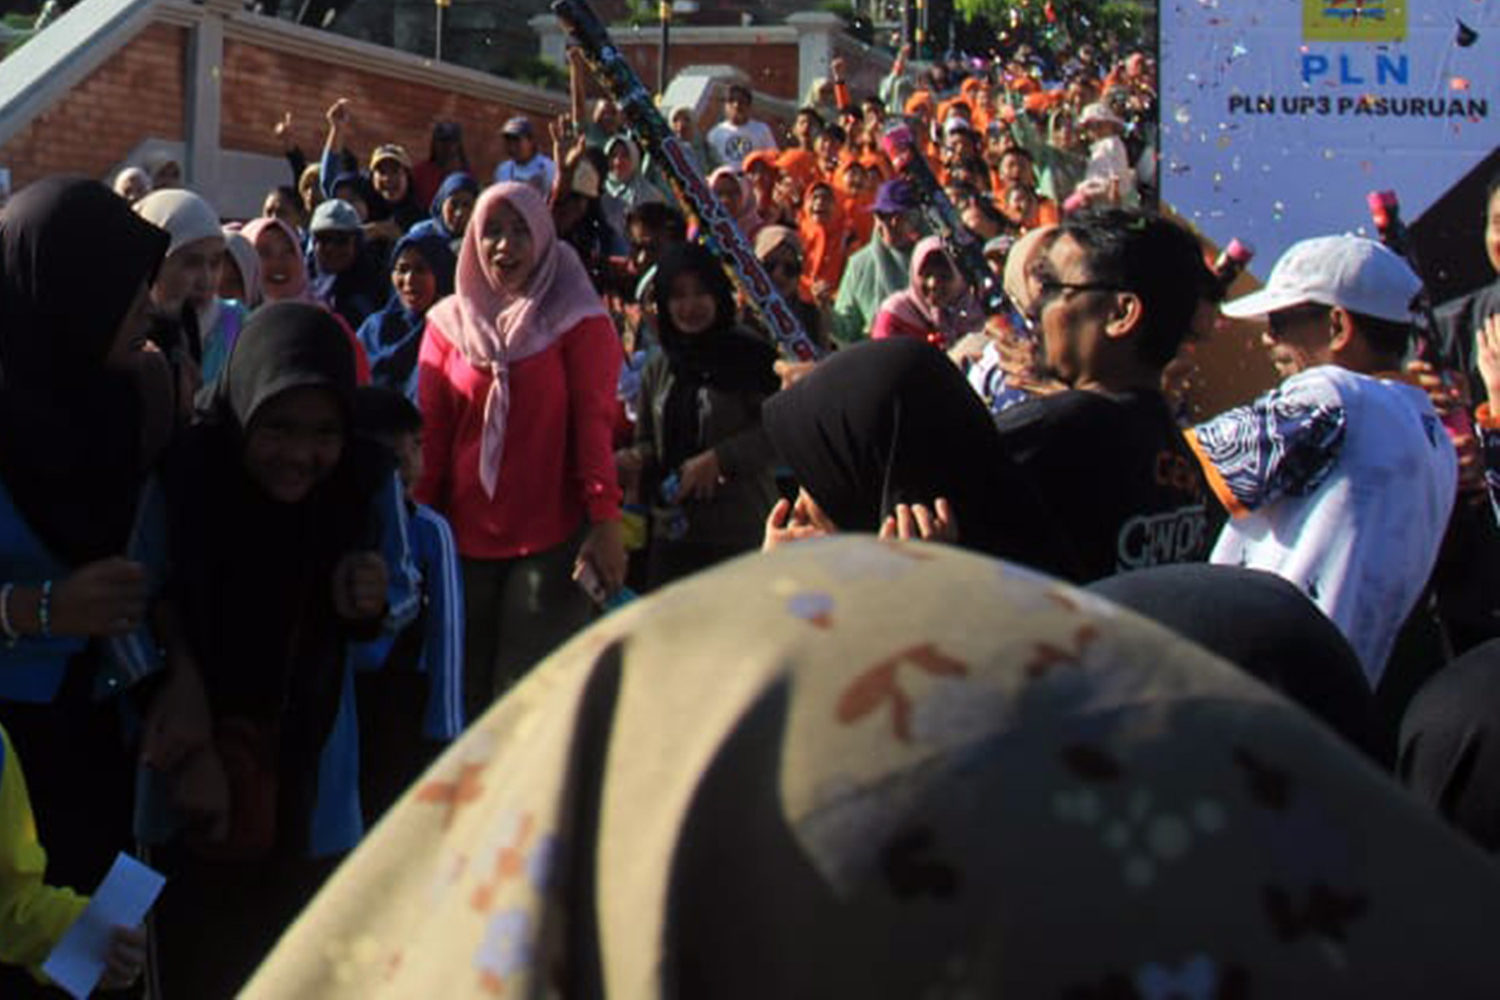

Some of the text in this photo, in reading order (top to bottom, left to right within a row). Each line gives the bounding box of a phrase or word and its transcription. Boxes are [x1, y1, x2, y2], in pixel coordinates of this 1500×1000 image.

[1302, 54, 1409, 86] PLN
[1229, 94, 1489, 119] PLN UP3 PASURUAN
